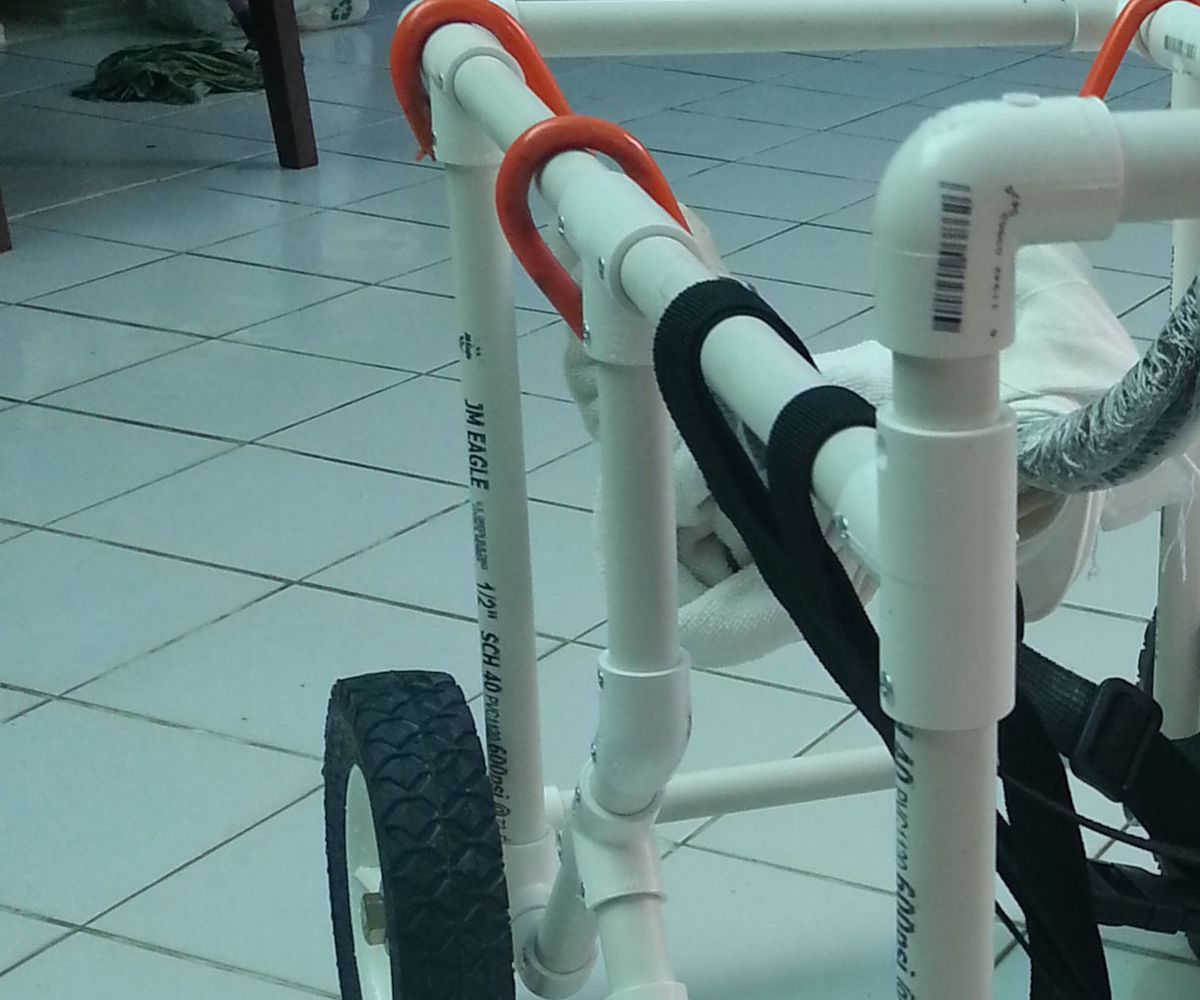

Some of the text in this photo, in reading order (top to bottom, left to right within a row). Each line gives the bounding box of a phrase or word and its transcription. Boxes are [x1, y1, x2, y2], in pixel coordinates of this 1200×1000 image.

[464, 398, 485, 427] JM
[467, 430, 490, 491] EAGLE
[476, 582, 498, 620] 1/2"
[481, 630, 500, 667] SCH
[483, 670, 503, 694] 40
